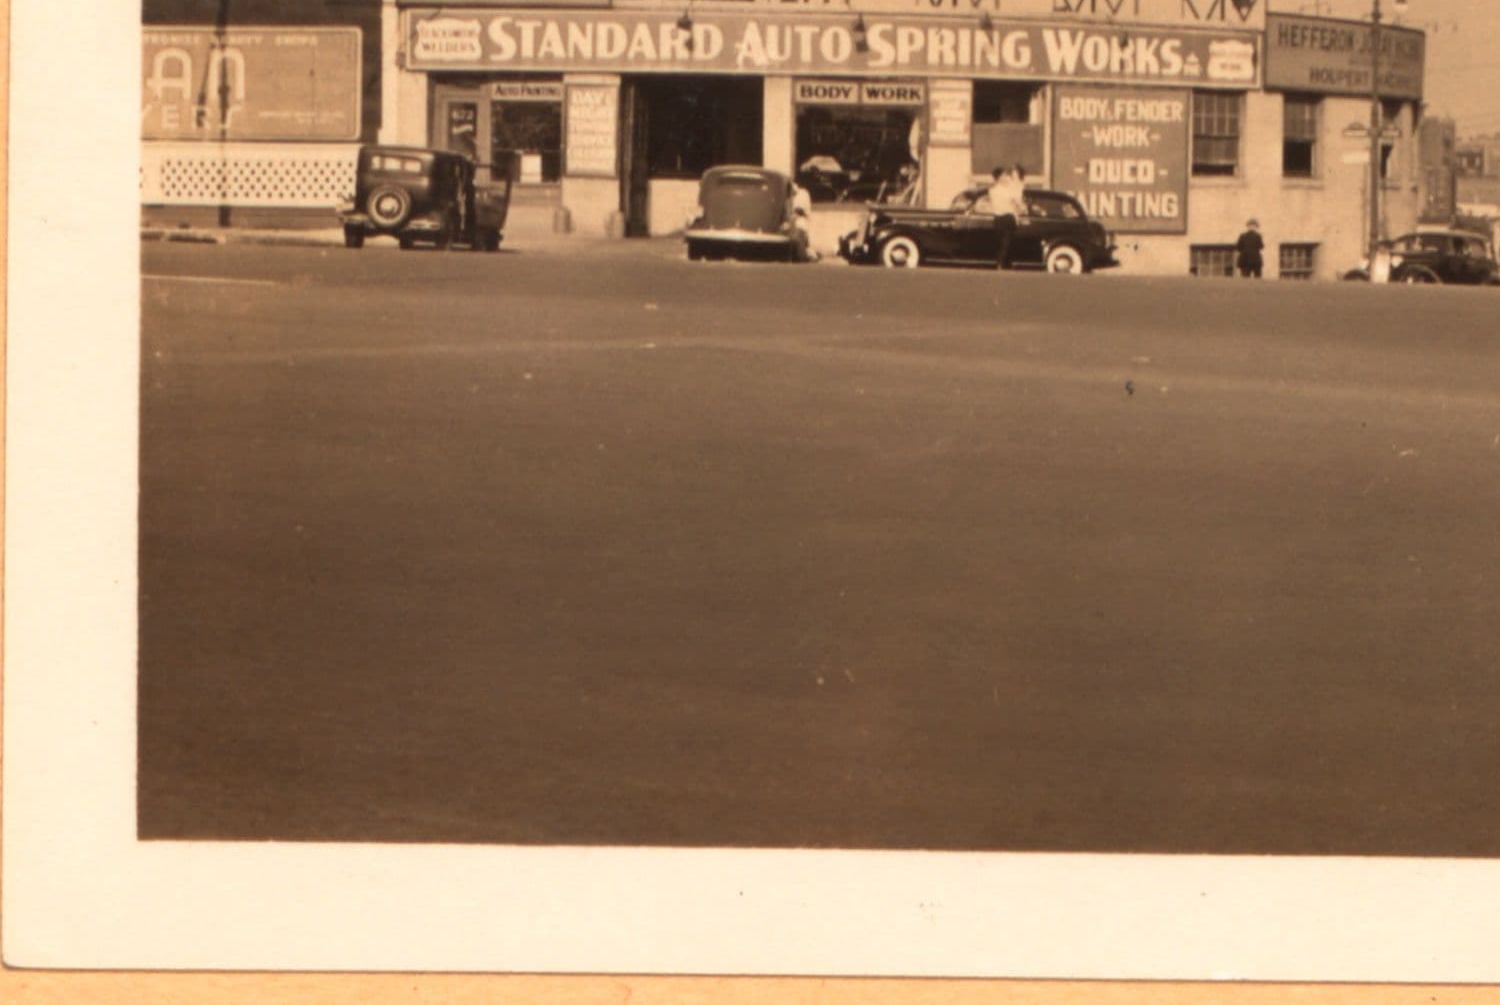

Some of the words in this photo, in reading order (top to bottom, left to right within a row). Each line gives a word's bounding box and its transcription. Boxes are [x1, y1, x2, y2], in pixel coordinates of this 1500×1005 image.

[488, 17, 724, 61] STANDARD
[735, 20, 852, 67] AUTO
[866, 23, 1031, 69] SPRING
[1042, 30, 1185, 75] WORKS
[799, 84, 852, 99] BODY
[866, 86, 921, 100] WORK
[1060, 97, 1108, 119] BODY
[1115, 98, 1183, 122] FENDER
[1067, 191, 1179, 219] AINTING
